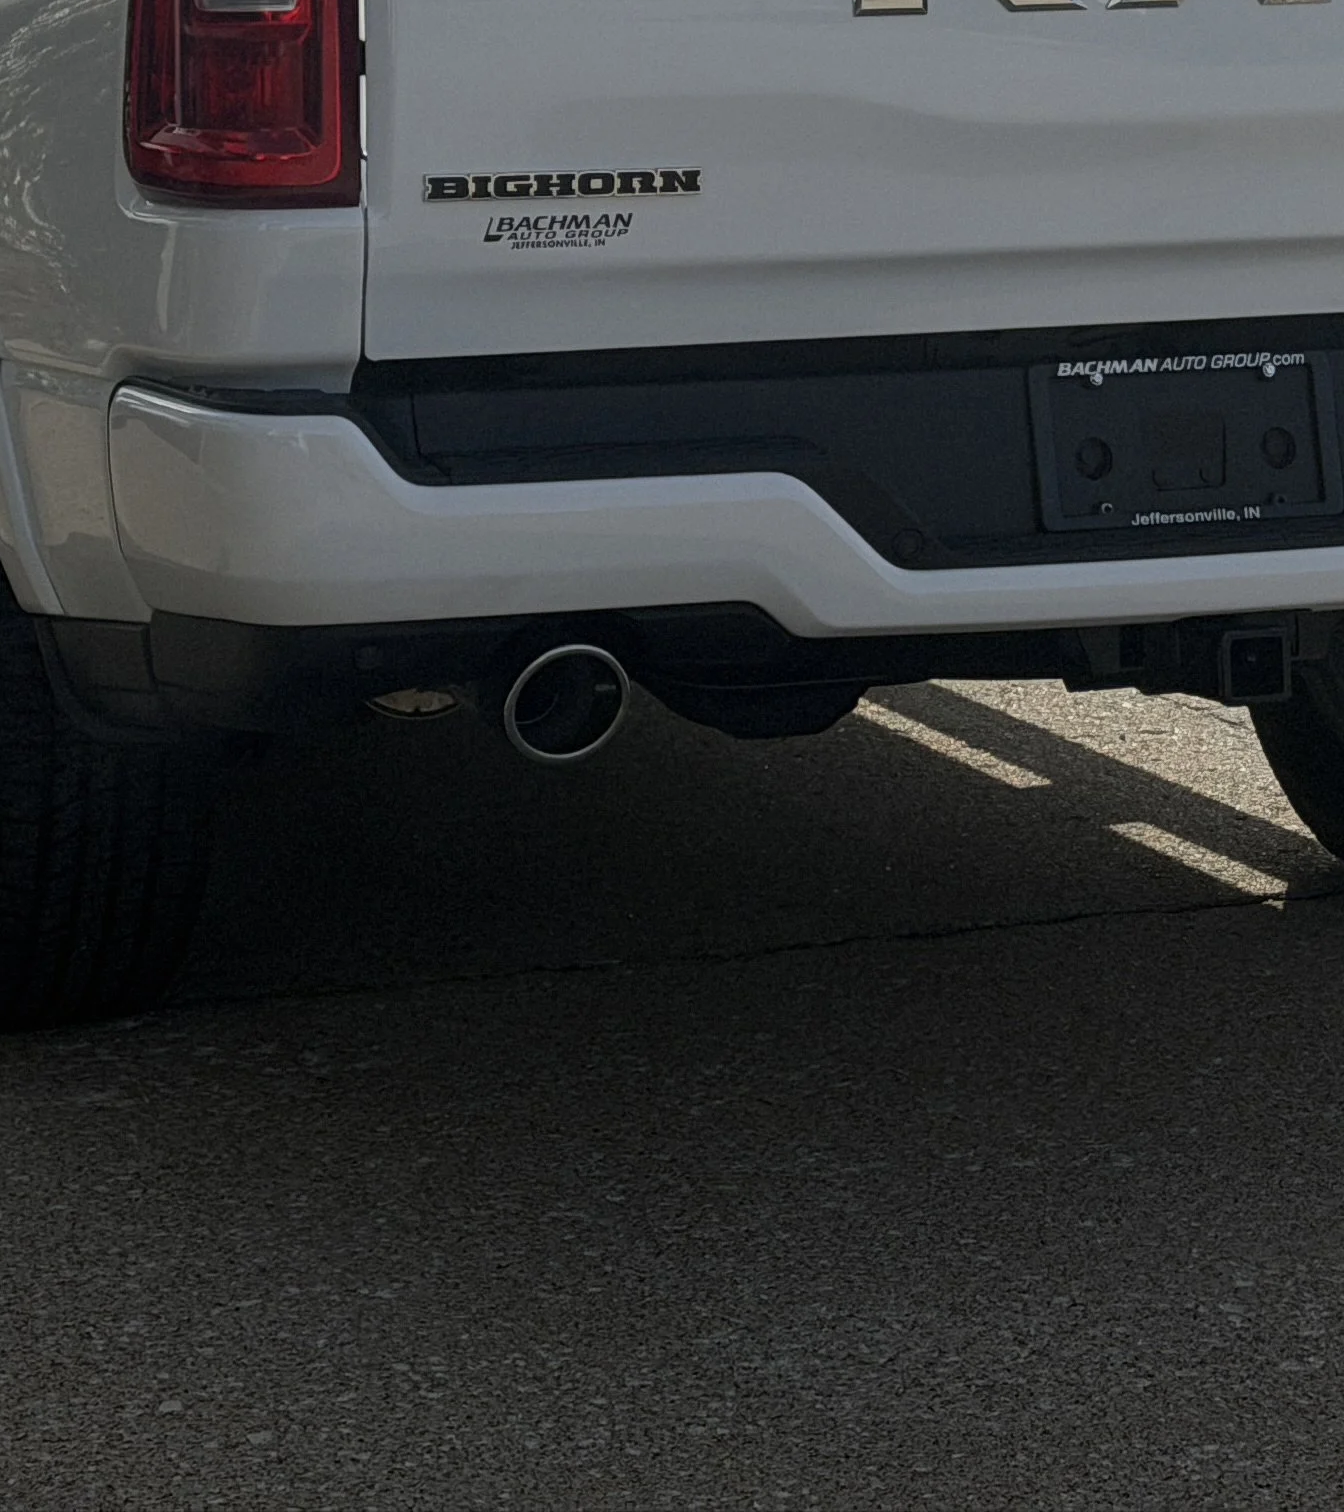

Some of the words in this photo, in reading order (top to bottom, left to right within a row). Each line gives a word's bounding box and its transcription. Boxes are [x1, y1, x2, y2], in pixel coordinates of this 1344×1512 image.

[424, 168, 702, 201] BIGHORN
[496, 212, 633, 233] BACHMAN
[507, 230, 558, 241] AUTO
[565, 228, 629, 239] GROUP
[594, 238, 606, 247] IN
[1057, 358, 1157, 377] BACHMAN
[1160, 355, 1207, 371] AUTO
[1131, 507, 1241, 527] Jeffersonville,
[1244, 506, 1261, 519] IN
